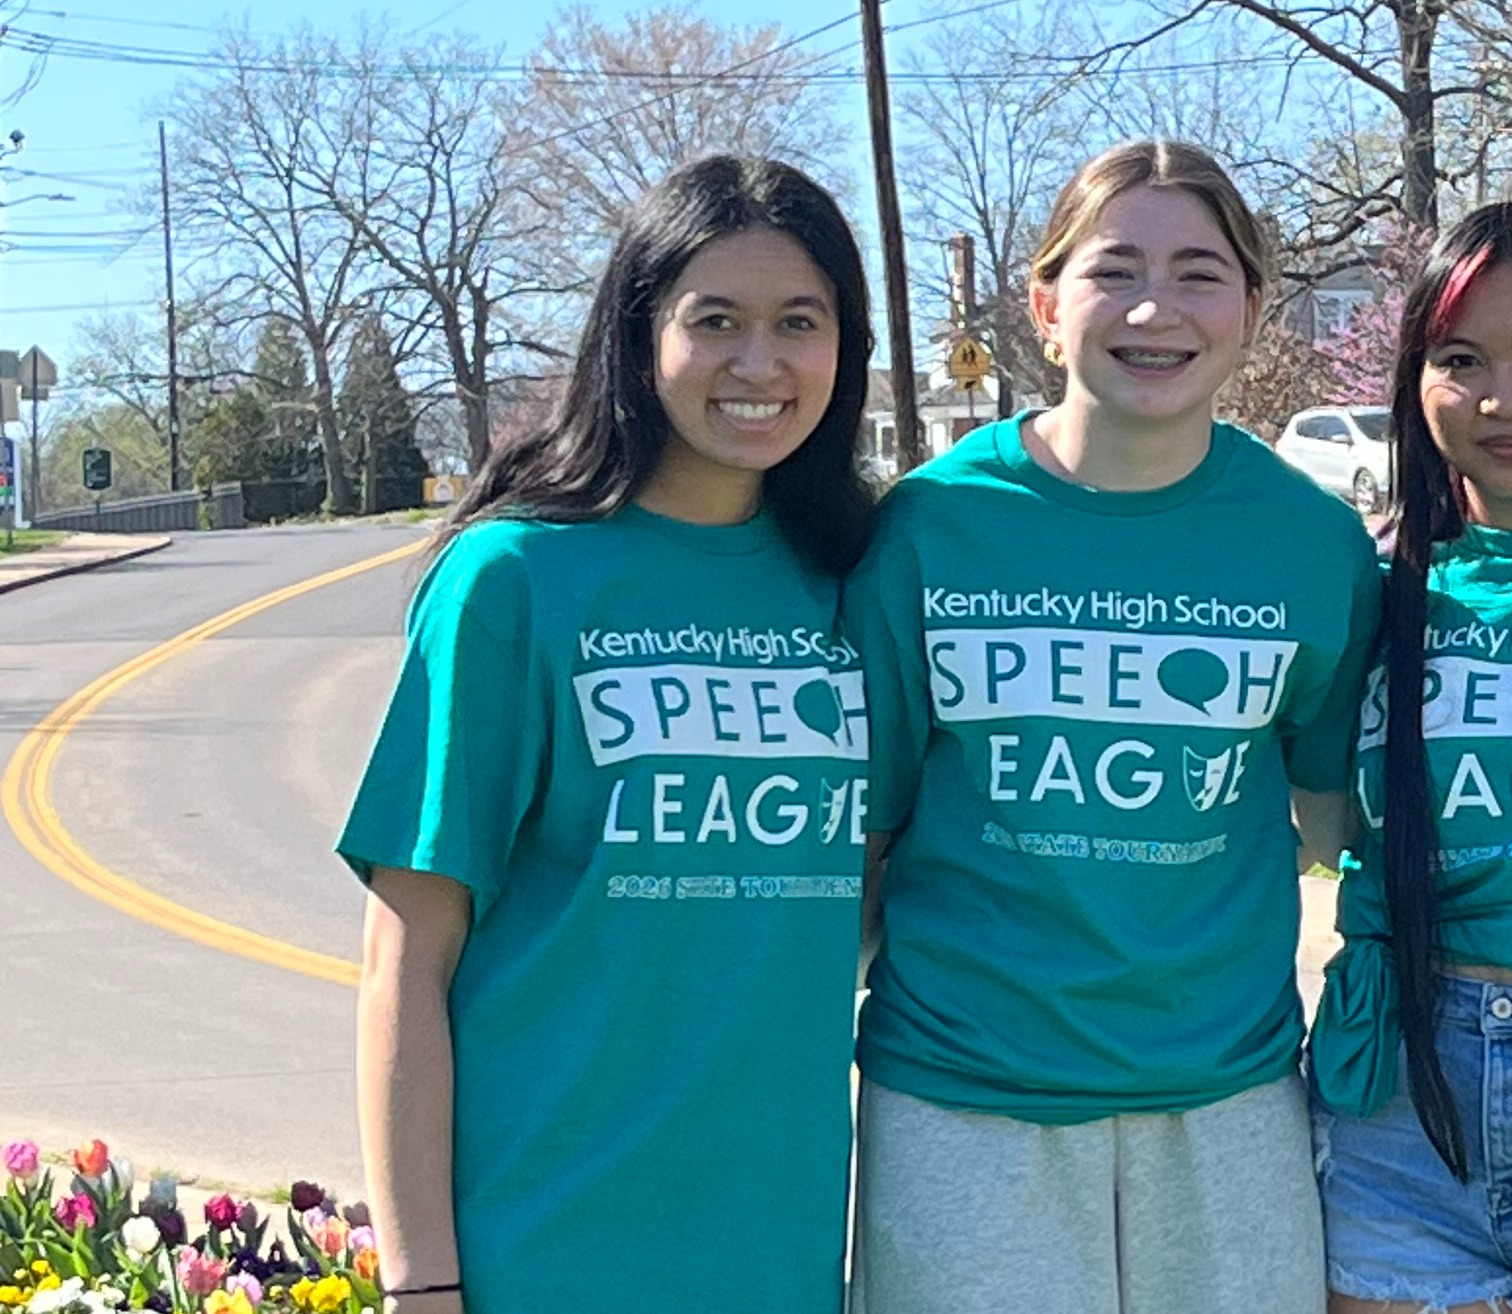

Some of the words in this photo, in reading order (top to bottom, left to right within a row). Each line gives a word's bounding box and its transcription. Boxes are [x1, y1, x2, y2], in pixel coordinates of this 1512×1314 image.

[924, 587, 1084, 624] Kentucky
[1091, 591, 1167, 629] High
[1175, 596, 1286, 630] School
[579, 623, 724, 662] Kentucky
[727, 626, 790, 664] High
[792, 627, 860, 665] Scl
[1423, 620, 1509, 658] tucky
